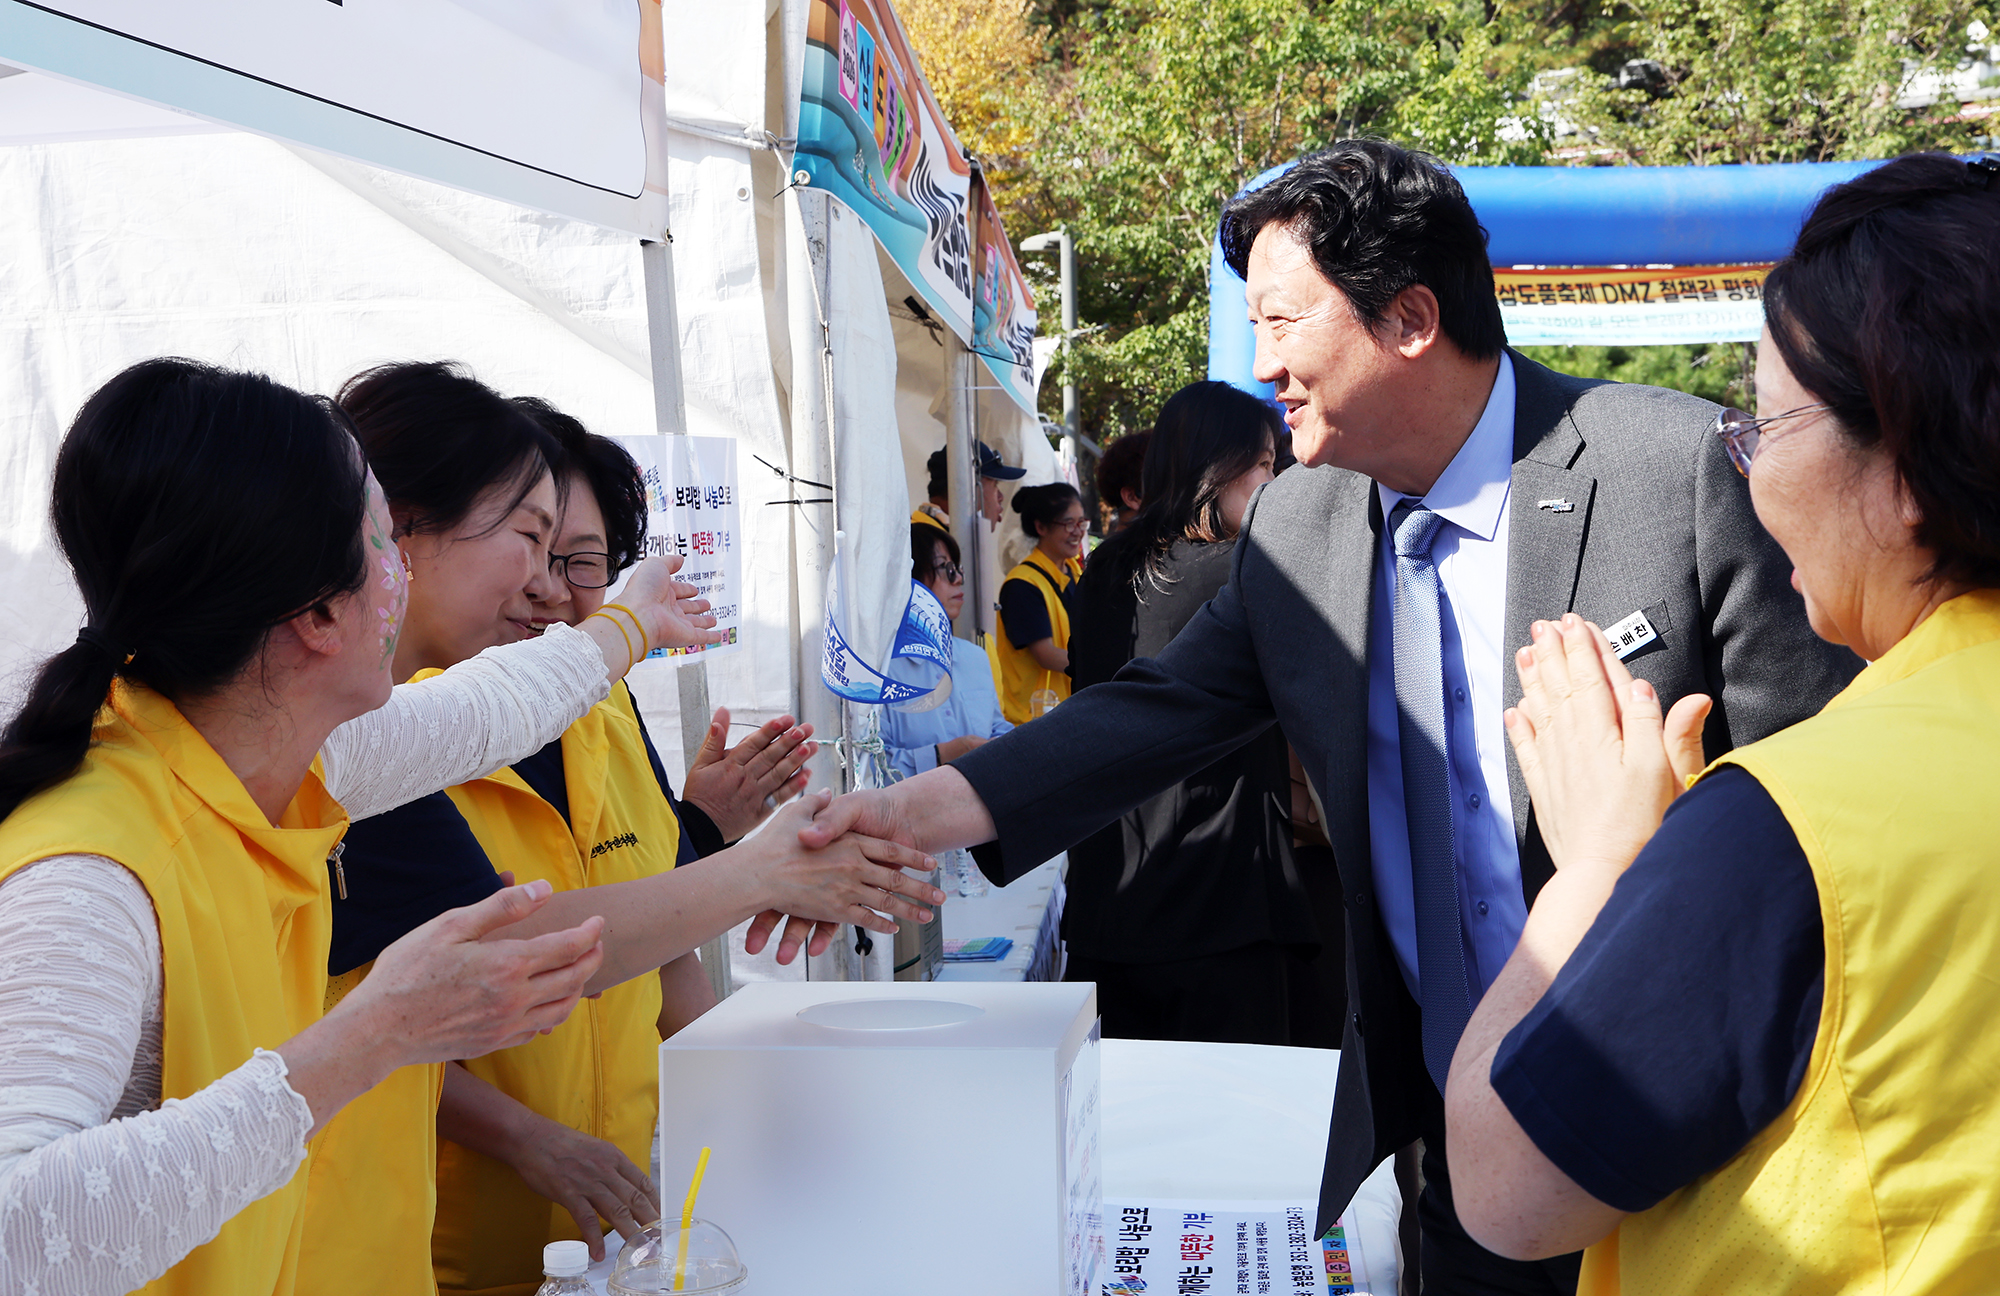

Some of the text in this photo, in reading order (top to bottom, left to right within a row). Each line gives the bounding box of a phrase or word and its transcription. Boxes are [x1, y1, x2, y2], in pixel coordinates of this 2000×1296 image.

[1499, 281, 1597, 306] 삼도품축제
[1601, 281, 1651, 304] DMZ
[1659, 279, 1717, 303] 철책길
[676, 485, 732, 510] 보리밥 나눔으로
[692, 530, 714, 556] 따뜻한
[717, 530, 731, 552] 기부
[1114, 1207, 1152, 1274] 보리밥 나눔으로
[1286, 1206, 1309, 1262] 351-1382-3324-73
[1177, 1212, 1213, 1296] 께하는 따뜻한 기부
[1290, 1264, 1315, 1287] 농협은행
